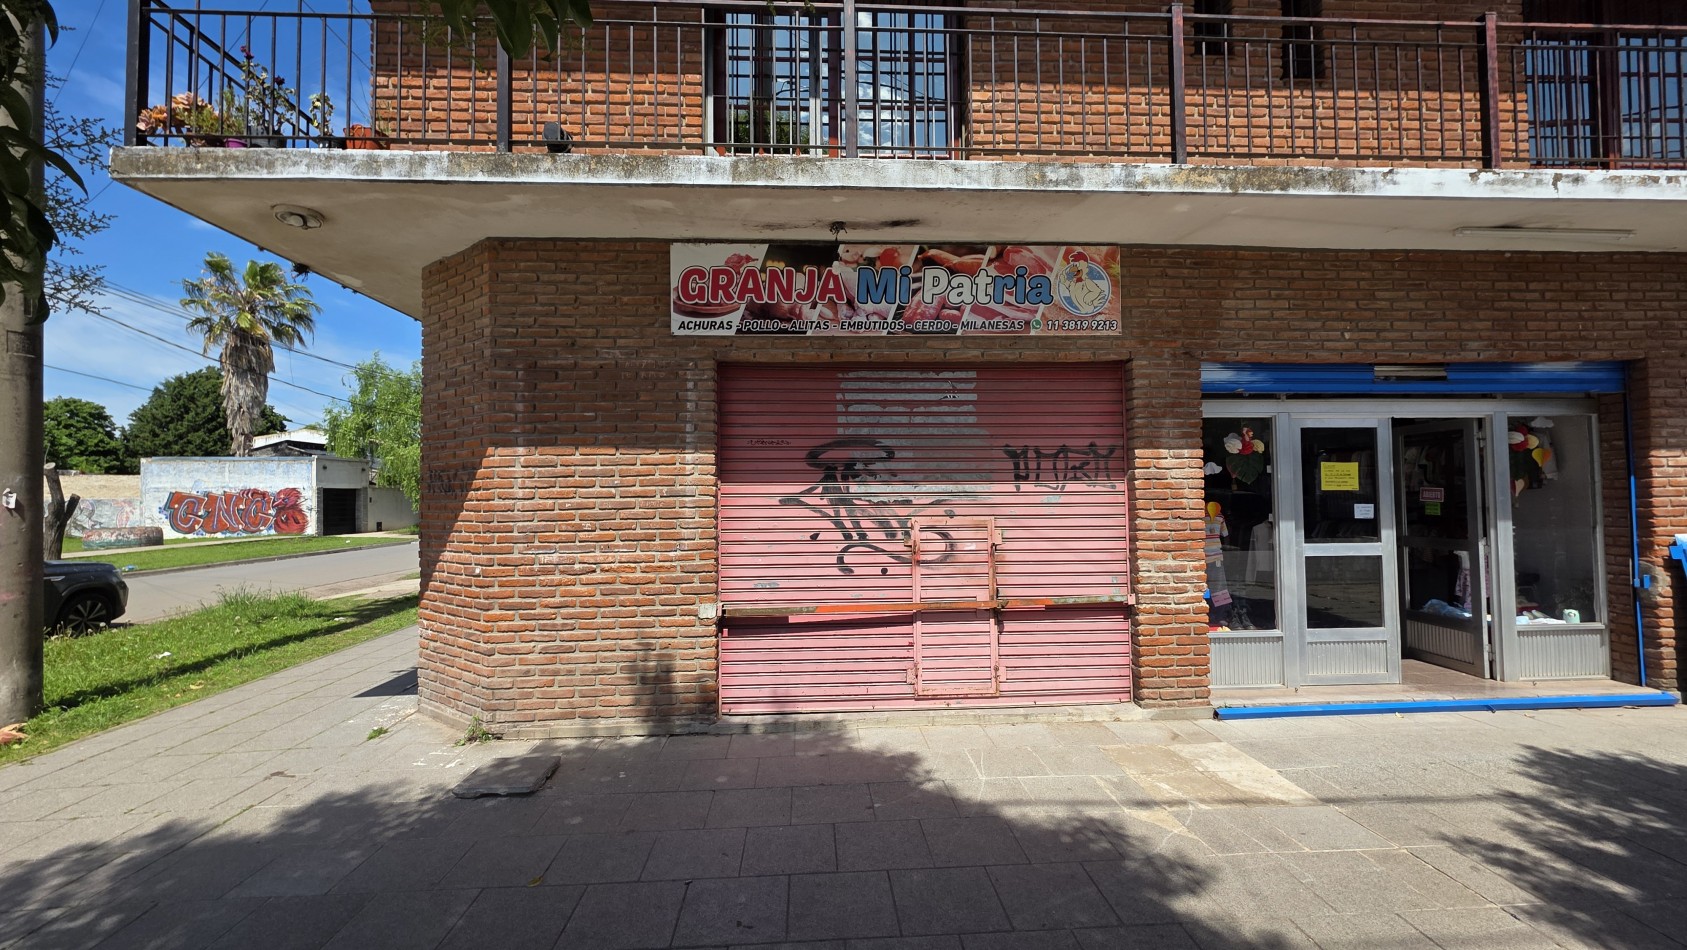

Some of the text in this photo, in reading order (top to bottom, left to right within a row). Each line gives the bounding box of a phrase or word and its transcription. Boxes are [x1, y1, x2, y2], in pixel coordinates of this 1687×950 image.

[678, 265, 1054, 305] GRANJA Mi Patria
[678, 320, 733, 331] ACHURAS
[742, 320, 780, 331] POLLO
[789, 320, 830, 331] ALITAS
[840, 320, 906, 331] EMBUTIDOS
[914, 320, 950, 331] CERDO
[960, 320, 1025, 331] MILANESAS
[1046, 320, 1118, 331] 11 3819 9213
